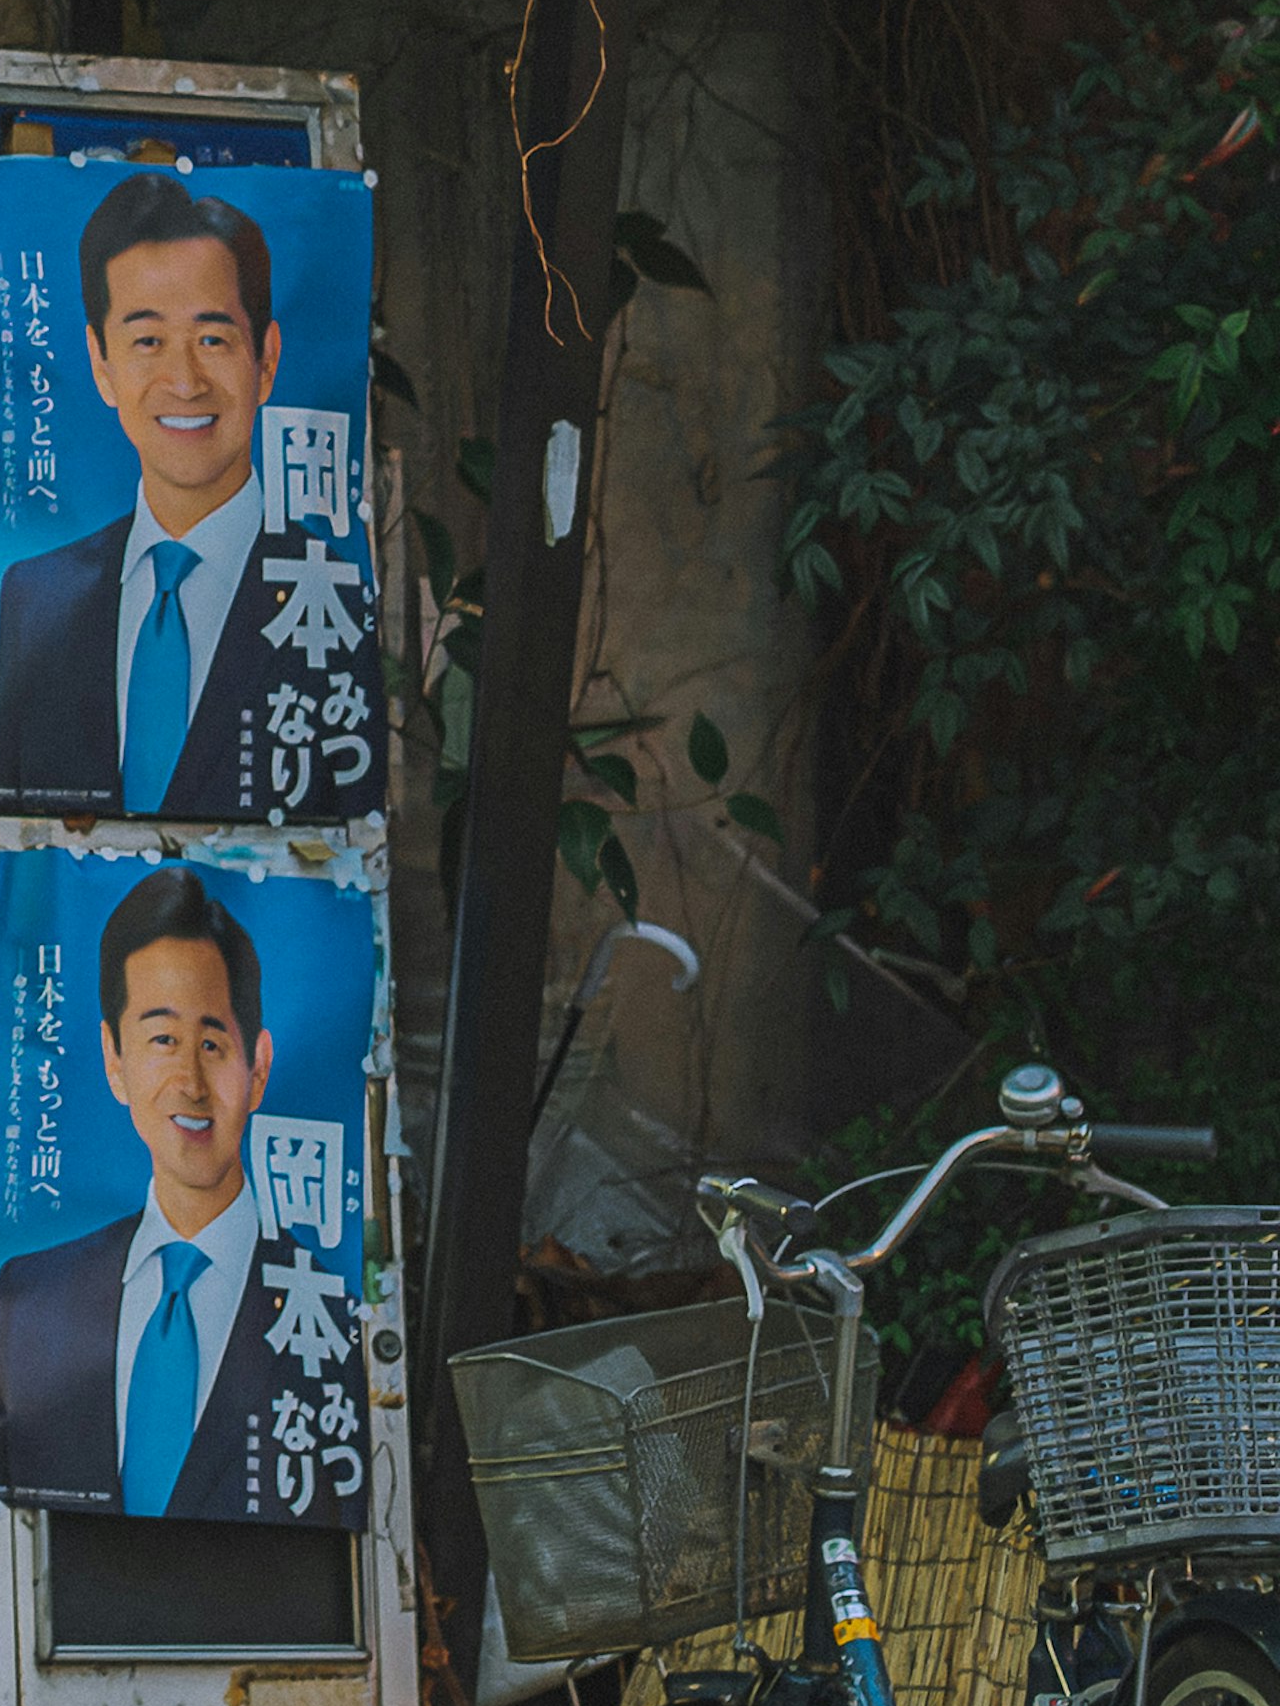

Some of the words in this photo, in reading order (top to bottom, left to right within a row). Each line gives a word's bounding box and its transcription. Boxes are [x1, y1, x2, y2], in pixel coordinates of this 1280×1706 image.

[260, 405, 364, 670] 岡本
[266, 682, 318, 808] なり
[321, 670, 372, 786] みつ
[249, 1113, 352, 1378] 岡本
[271, 1389, 317, 1518] なり
[319, 1382, 363, 1497] みつ
